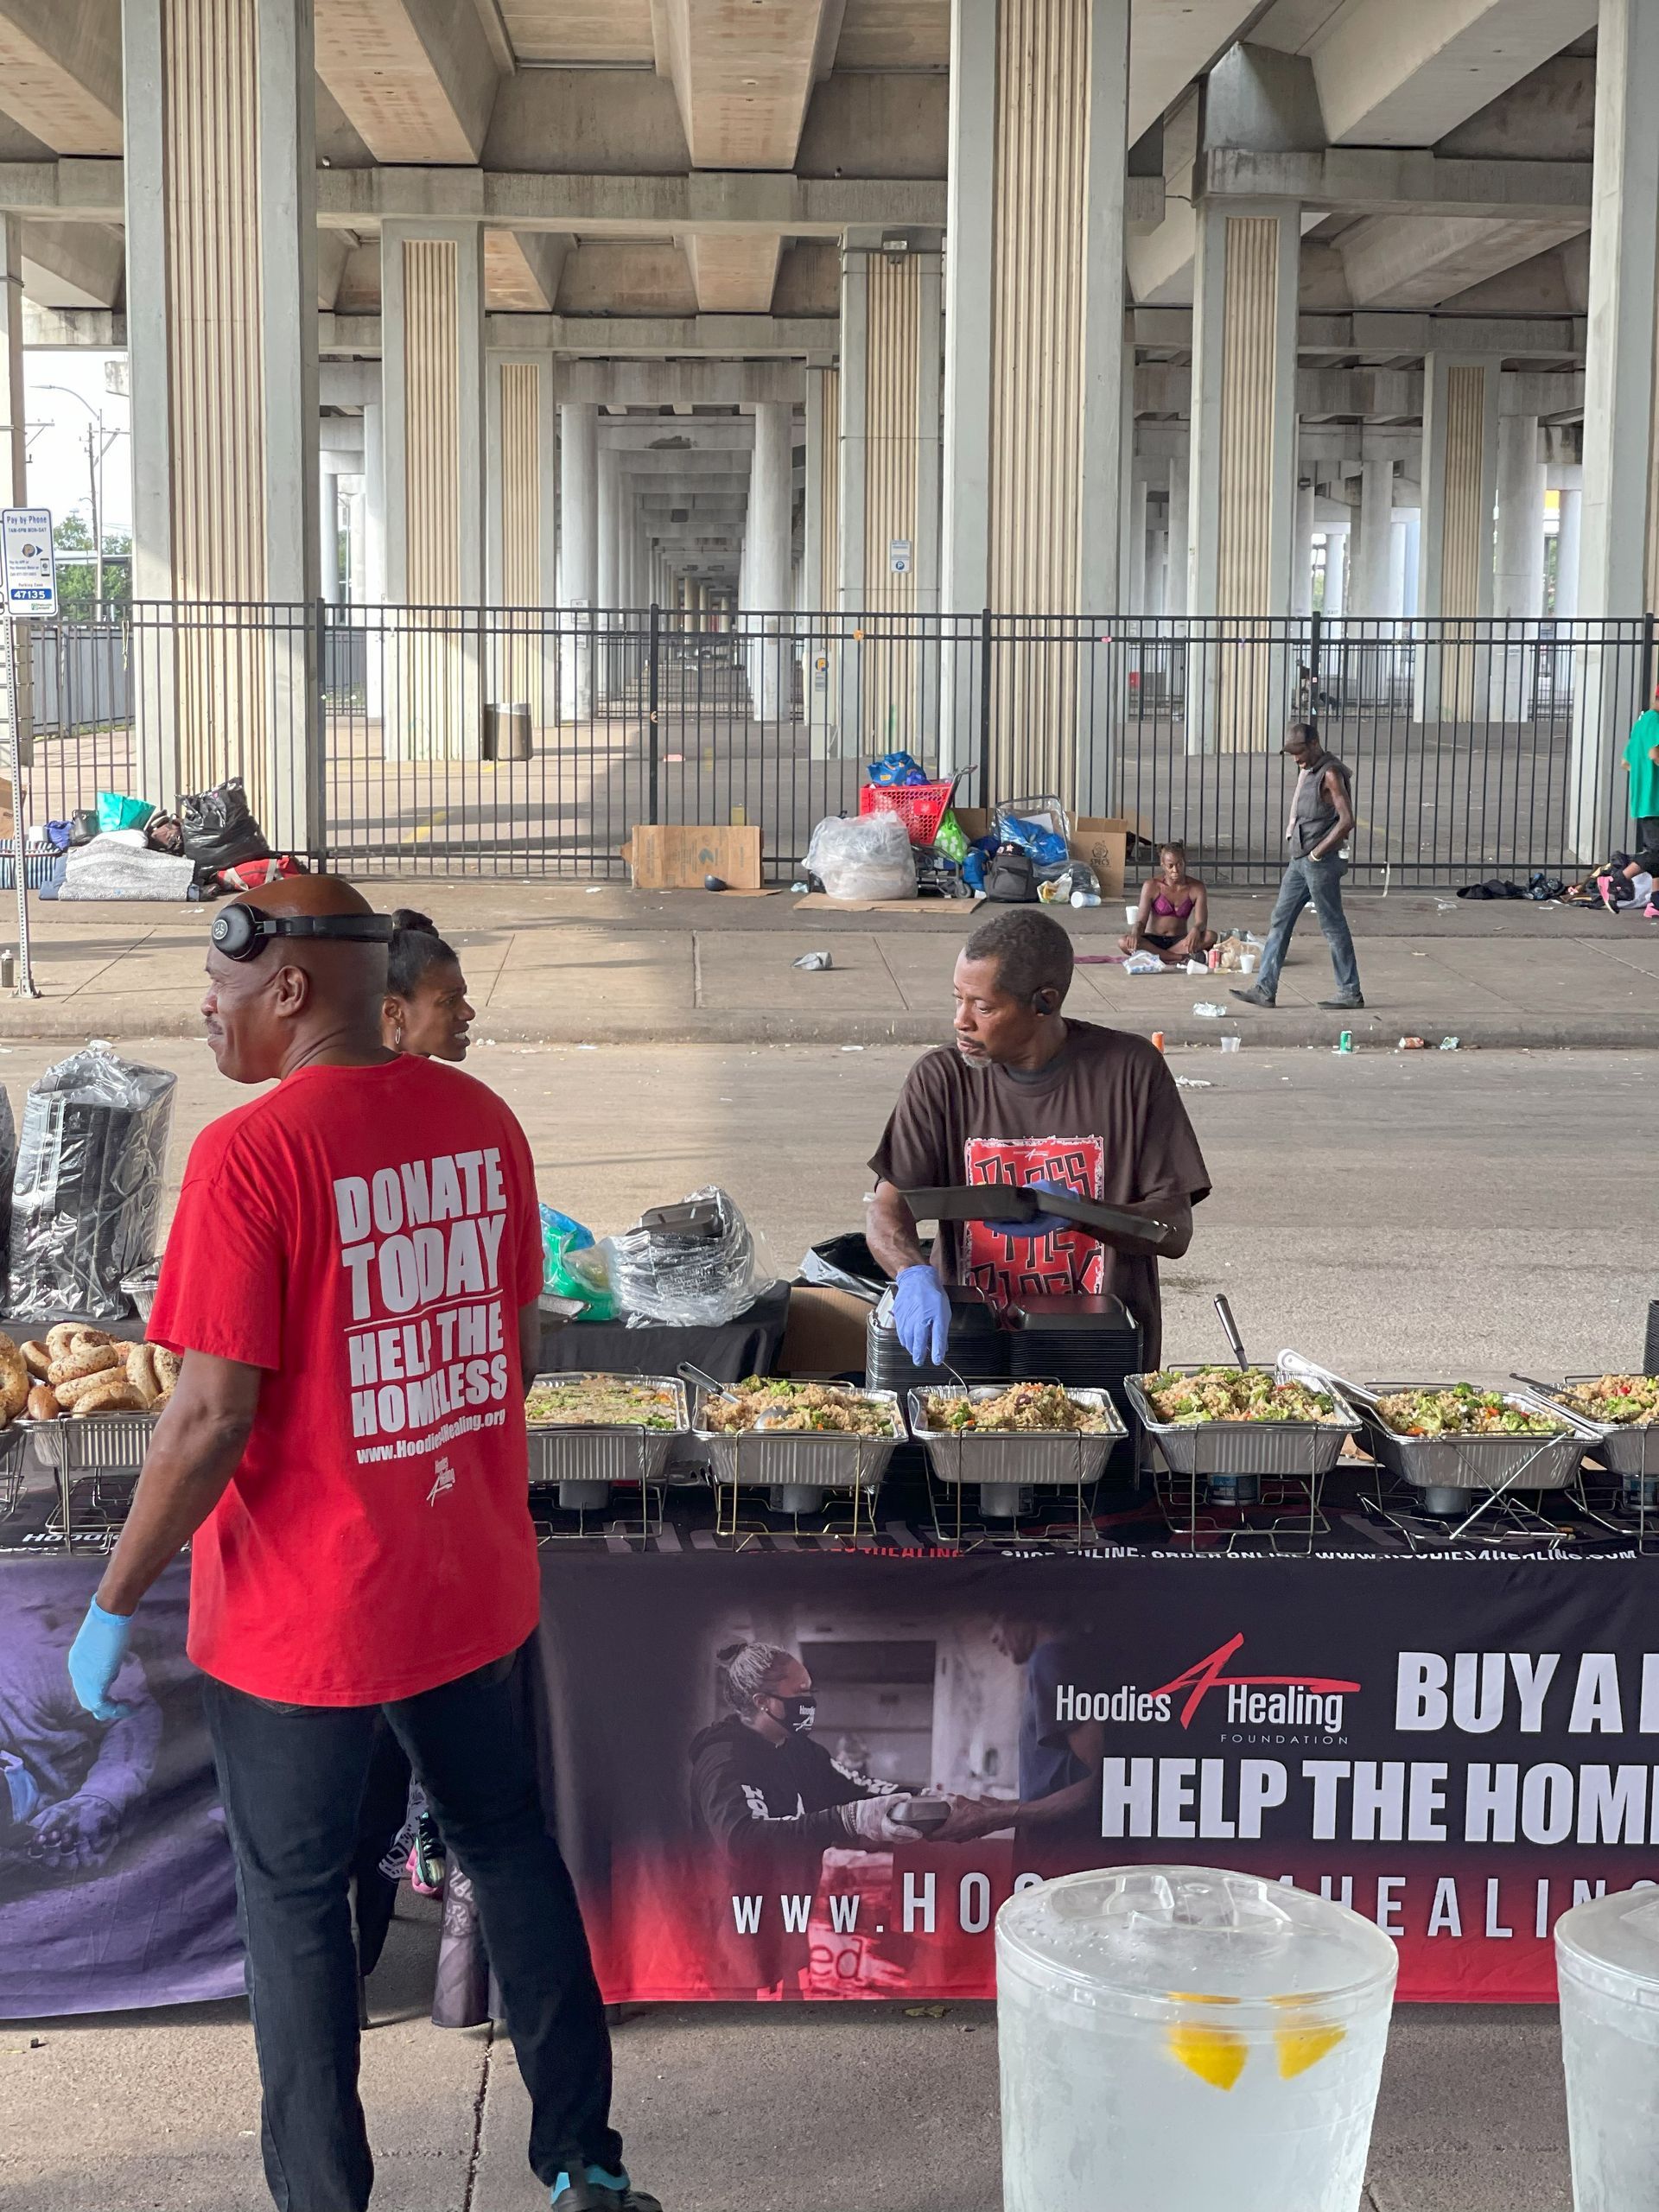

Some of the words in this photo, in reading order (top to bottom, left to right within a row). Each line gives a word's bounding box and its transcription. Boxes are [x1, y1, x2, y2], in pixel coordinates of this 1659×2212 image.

[7, 516, 17, 524] Pay
[20, 516, 27, 524] by
[29, 515, 47, 524] Phone
[14, 590, 46, 599] 47135
[334, 1147, 507, 1244] DONATE
[341, 1213, 506, 1321] TODAY
[348, 1319, 432, 1388] HELP
[435, 1300, 504, 1363] THE
[1056, 1684, 1172, 1722] Hoodies
[1227, 1683, 1344, 1734] Healing
[1395, 1651, 1561, 1733] BUY
[1567, 1652, 1624, 1733] A
[1220, 1733, 1349, 1745] FOUNDATION
[1101, 1757, 1288, 1839] HELP
[1301, 1759, 1448, 1841] THE
[1464, 1762, 1659, 1846] HOM
